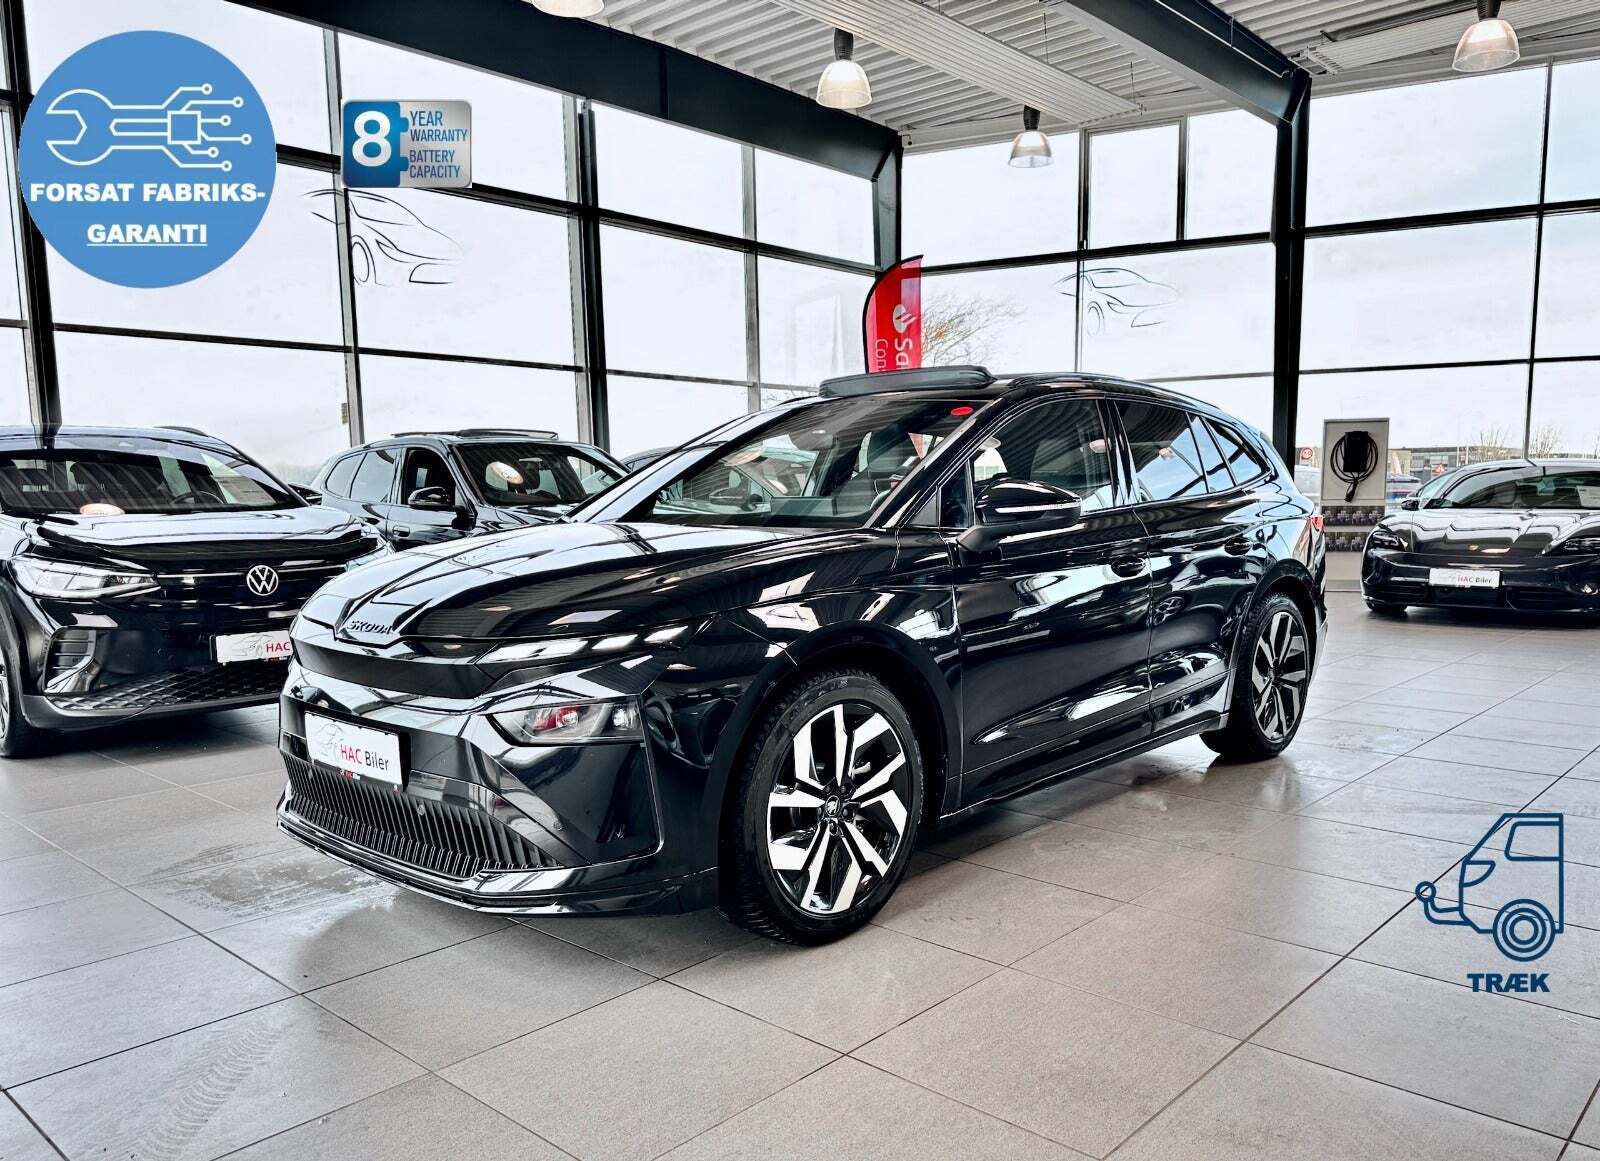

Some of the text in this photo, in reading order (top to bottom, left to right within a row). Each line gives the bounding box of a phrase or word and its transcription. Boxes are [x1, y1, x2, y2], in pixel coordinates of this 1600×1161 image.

[894, 338, 913, 370] Sa
[266, 641, 290, 653] HAC
[340, 744, 389, 771] HAC Biler
